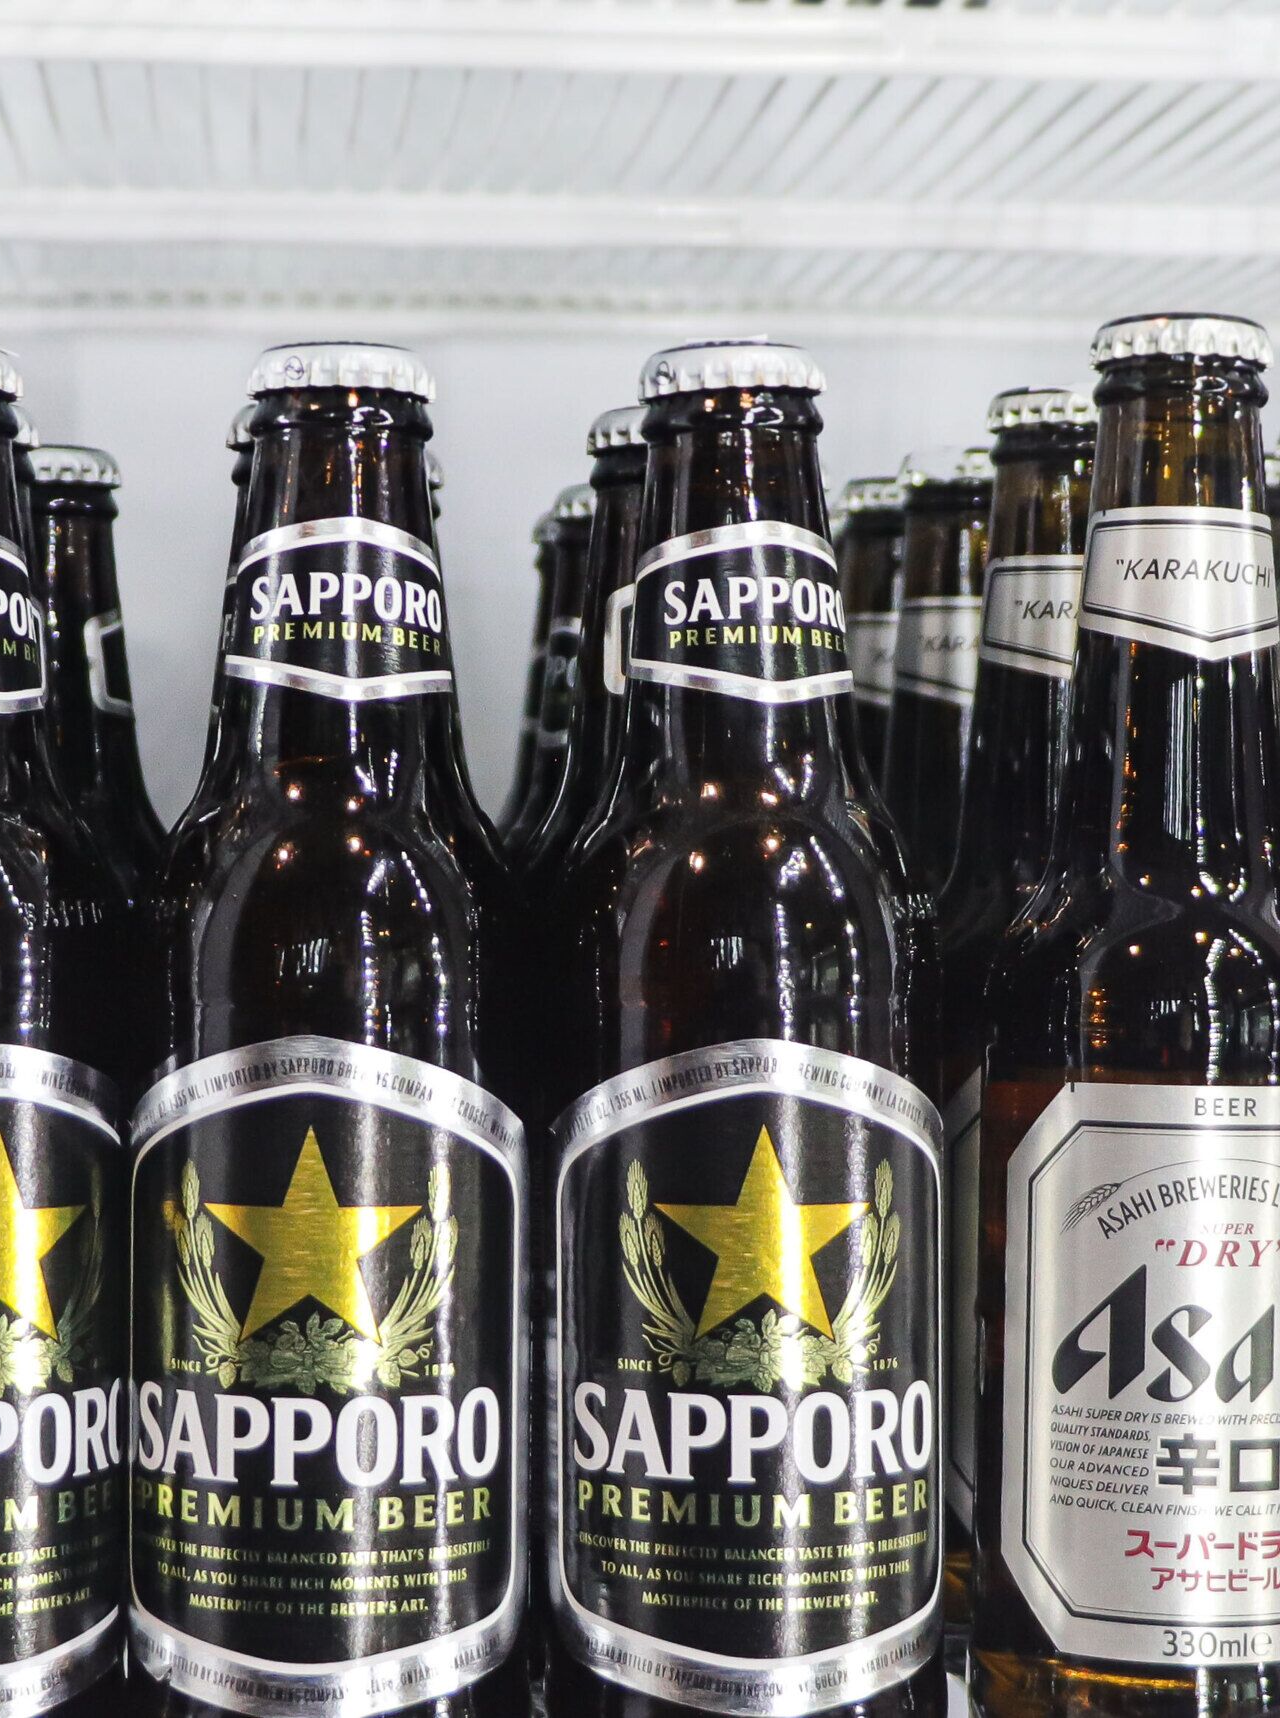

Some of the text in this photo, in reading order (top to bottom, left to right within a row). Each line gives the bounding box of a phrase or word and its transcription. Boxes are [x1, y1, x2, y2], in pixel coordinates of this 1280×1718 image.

[250, 571, 442, 633] SAPPORO
[253, 622, 441, 656] PREMIUM BEER
[669, 626, 803, 649] PREMIUM
[1194, 1097, 1257, 1117] BEER
[1097, 1189, 1158, 1239] ASAHI
[1161, 1174, 1269, 1208] BREWERIES
[1201, 1223, 1254, 1236] SUPER
[170, 1357, 201, 1374] SINCE
[617, 1357, 653, 1373] SINCE
[873, 1357, 898, 1373] 1876
[1051, 1404, 1082, 1418] ASAHI
[1085, 1408, 1122, 1421] SUPER
[1124, 1411, 1149, 1424] DRY
[1218, 1413, 1247, 1426] WITH
[138, 1380, 501, 1487] SAPPORO
[573, 1379, 933, 1484] SAPPORO
[1050, 1421, 1151, 1442] QUALITY STANDARDS,
[1050, 1440, 1149, 1459] VISION OF JAPANESE
[1050, 1457, 1150, 1477] OUR ADVANCED
[1050, 1475, 1149, 1495] NIQUES DELIVER
[139, 1477, 492, 1534] PREMIUM BEER
[577, 1478, 928, 1529] PREMIUM BEER
[1049, 1493, 1074, 1506] AND
[1121, 1501, 1163, 1515] CLEAN
[180, 1542, 198, 1558] THE
[200, 1545, 261, 1563] PERFECTLY
[267, 1551, 336, 1565] BALANCED
[381, 1548, 424, 1565] THAT'S
[579, 1532, 627, 1551] DISCOVER
[630, 1538, 650, 1555] THE
[654, 1542, 718, 1561] PERFECTLY
[724, 1546, 794, 1562] BALANCED
[798, 1544, 833, 1561] TASTE
[836, 1540, 874, 1558] THAT'S
[193, 1568, 438, 1591] AS YOU SHARE RICH MOMENTS WITH
[601, 1560, 910, 1587] TO ALL, AS YOU SHARE RICH MOMENTS WITH THIS
[189, 1592, 429, 1615] MASTERPIECE BREWER'S ART.
[641, 1590, 732, 1608] MASTERPIECE
[736, 1594, 754, 1609] OF
[757, 1595, 784, 1611] THE
